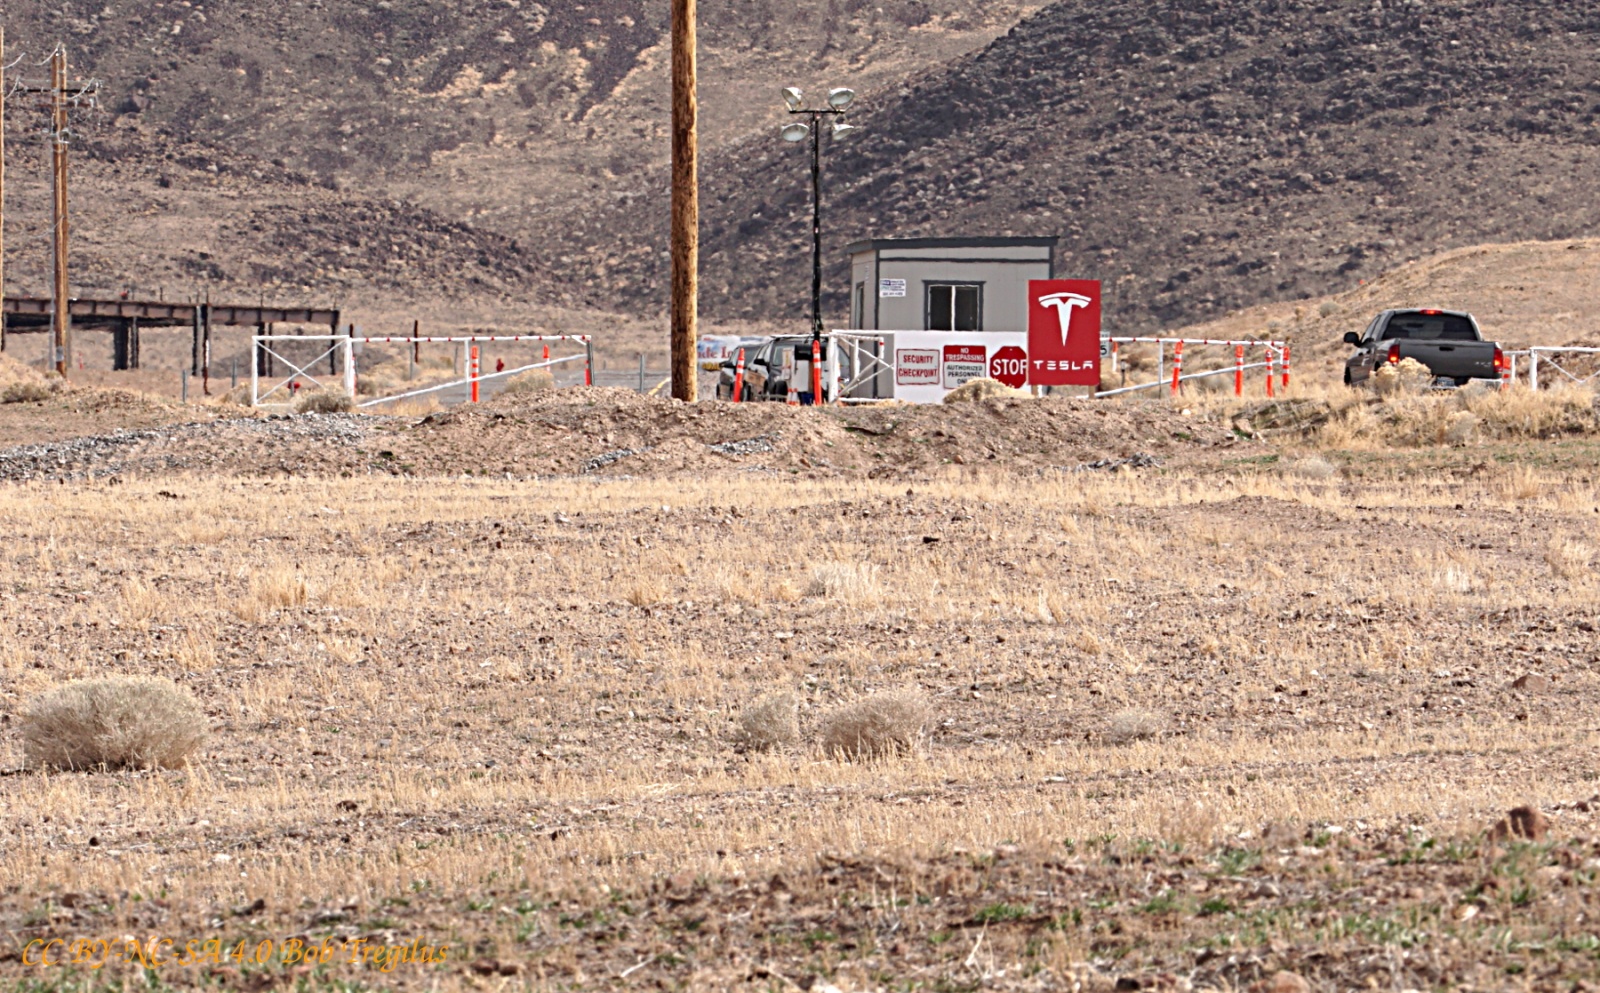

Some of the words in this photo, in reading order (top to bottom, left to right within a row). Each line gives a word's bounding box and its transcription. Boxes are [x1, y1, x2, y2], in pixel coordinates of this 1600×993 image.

[903, 354, 934, 364] SECURITY
[945, 354, 984, 362] TRESPASSING
[992, 359, 1027, 375] STOP
[1033, 360, 1093, 370] TESLA
[898, 368, 938, 378] CHECKPOINT
